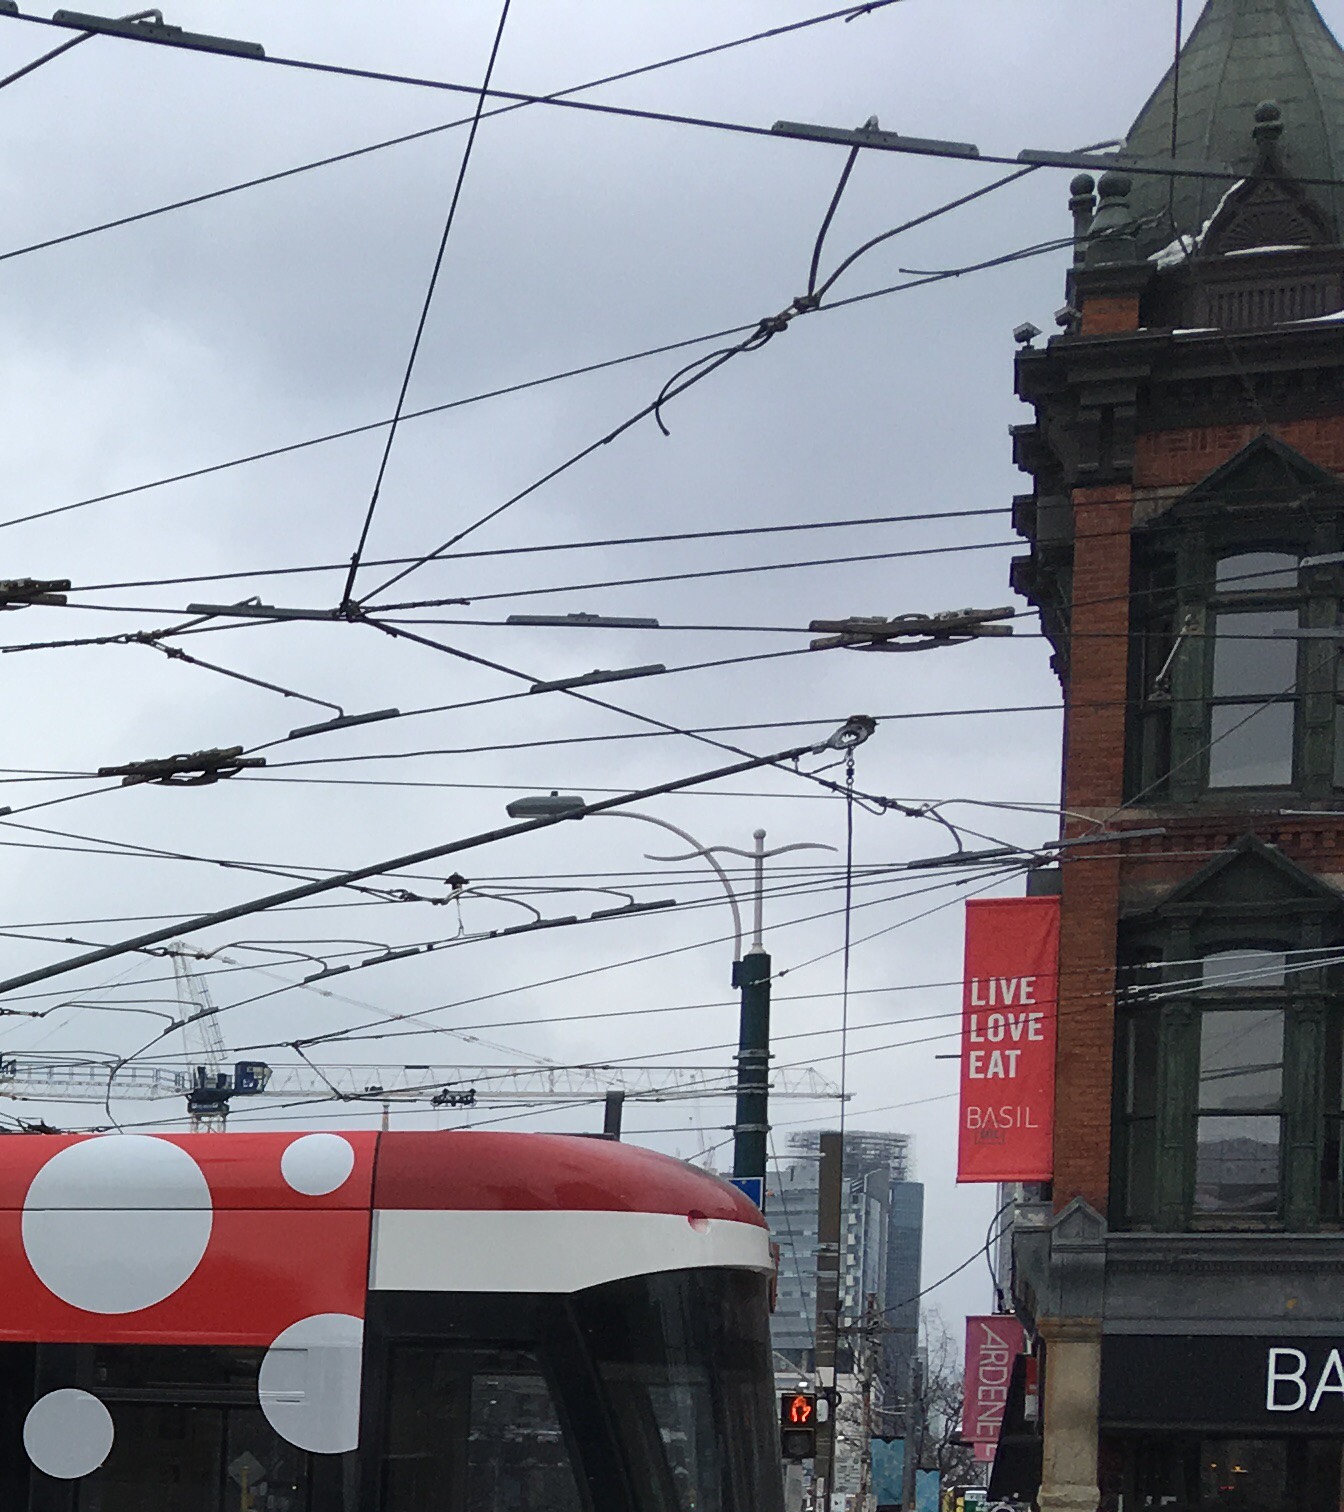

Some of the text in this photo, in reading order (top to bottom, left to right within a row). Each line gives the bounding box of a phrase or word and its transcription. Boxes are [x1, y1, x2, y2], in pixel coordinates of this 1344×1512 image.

[971, 977, 1036, 1006] LIVE
[970, 1013, 1044, 1042] LOVE
[969, 1049, 1021, 1079] EAT
[967, 1105, 1038, 1129] BASIL
[976, 1322, 1010, 1436] ARDENE
[1266, 1347, 1344, 1412] BA
